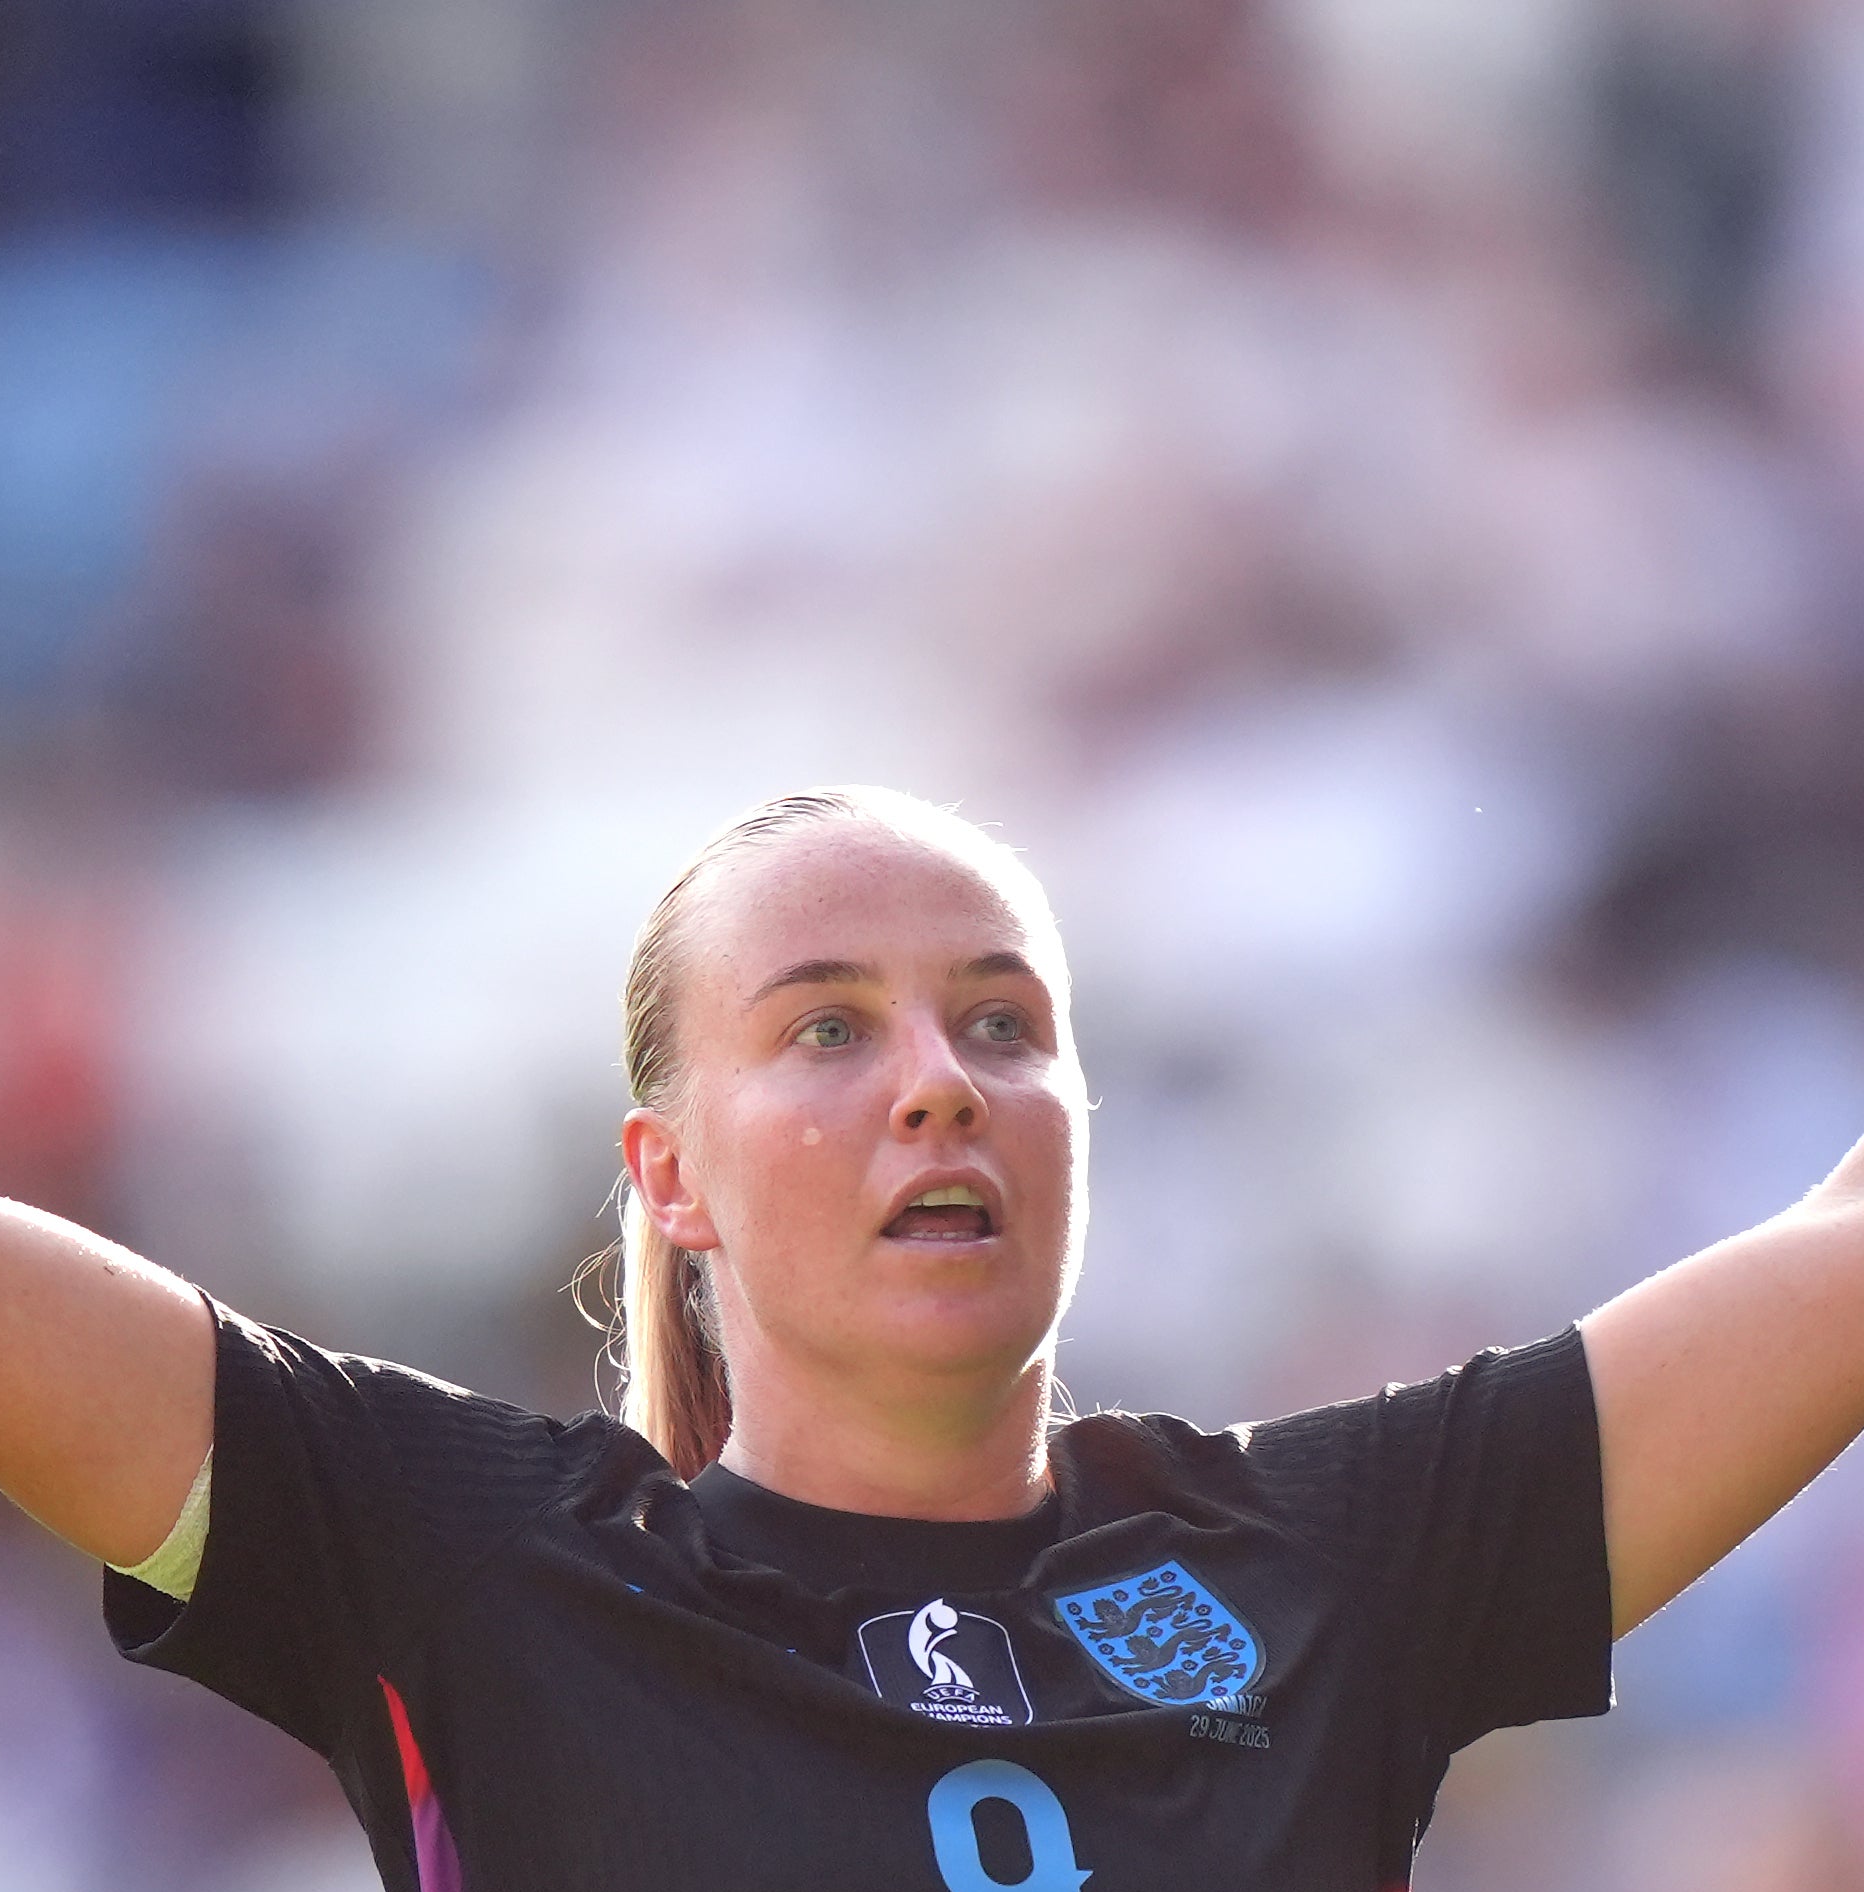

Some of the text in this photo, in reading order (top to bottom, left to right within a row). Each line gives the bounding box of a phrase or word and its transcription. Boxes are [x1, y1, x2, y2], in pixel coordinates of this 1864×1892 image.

[927, 1687, 976, 1701] UEFA
[910, 1702, 1004, 1715] EUROPEAN
[1189, 1714, 1210, 1738] 29
[1238, 1722, 1272, 1749] 2025
